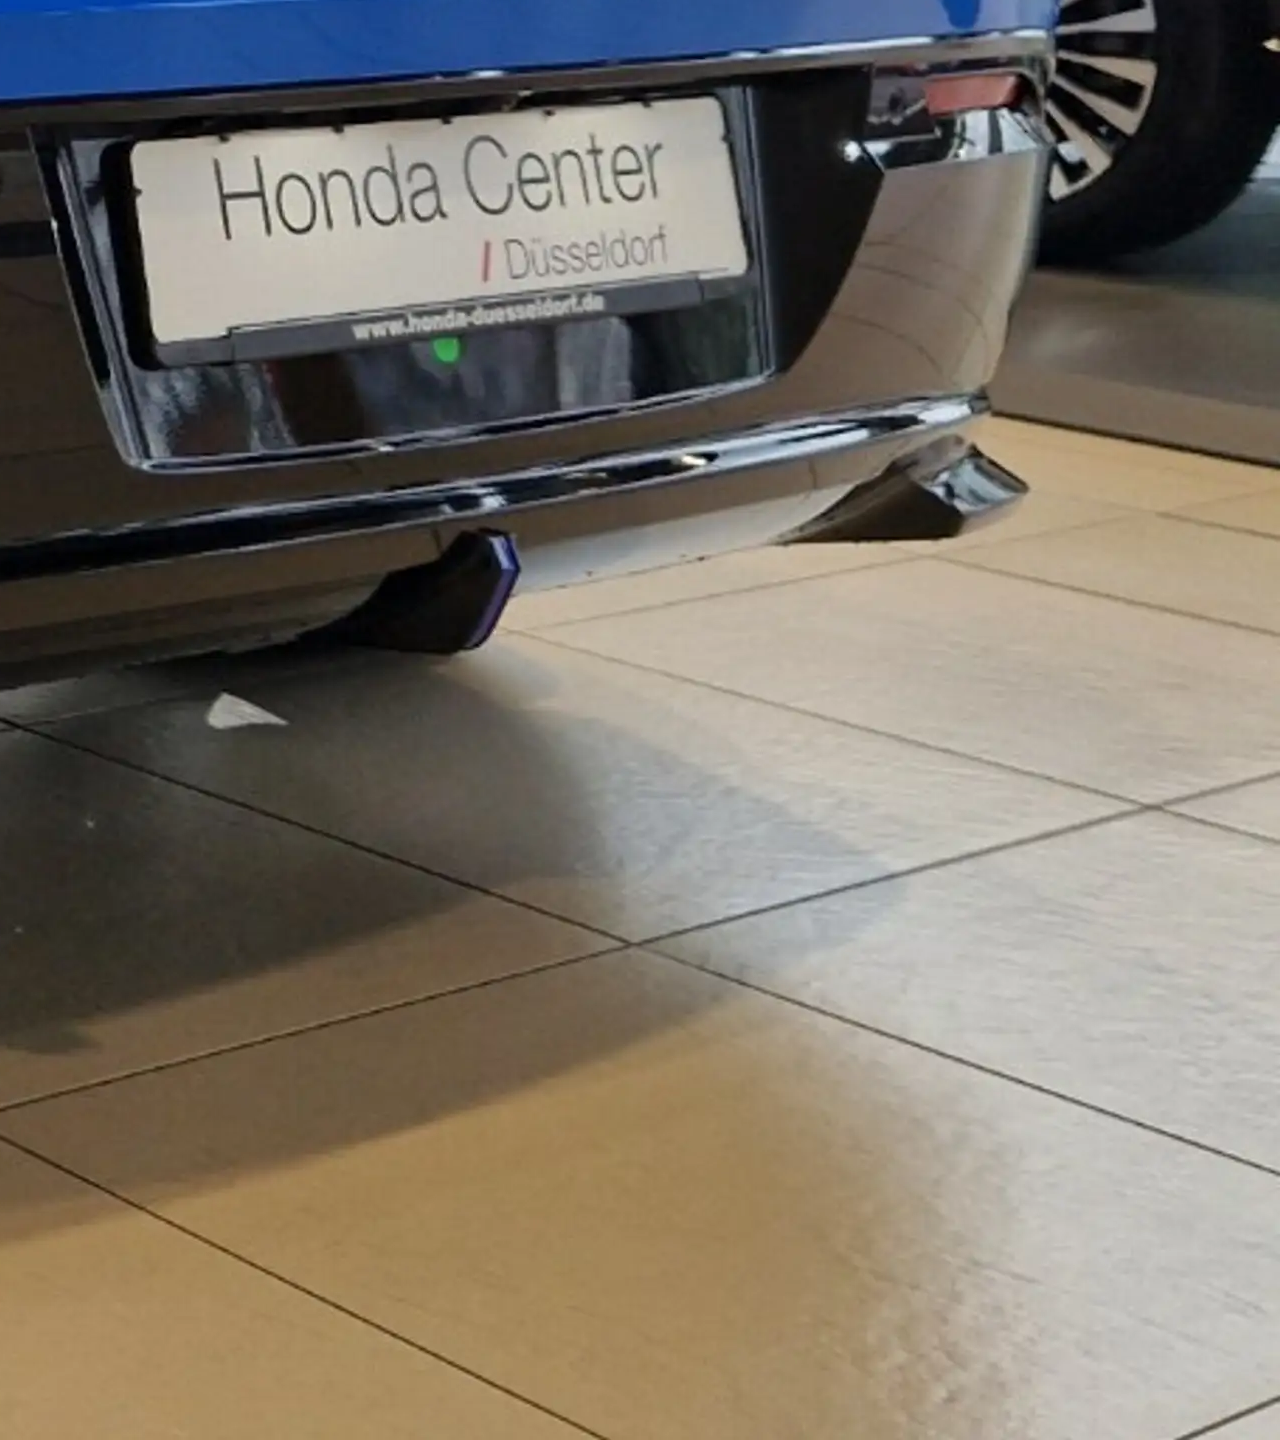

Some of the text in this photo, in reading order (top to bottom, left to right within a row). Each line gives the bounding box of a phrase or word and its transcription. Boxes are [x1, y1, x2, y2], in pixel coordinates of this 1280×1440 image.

[213, 133, 663, 241] Honda Center
[504, 225, 668, 281] Düsseldorf
